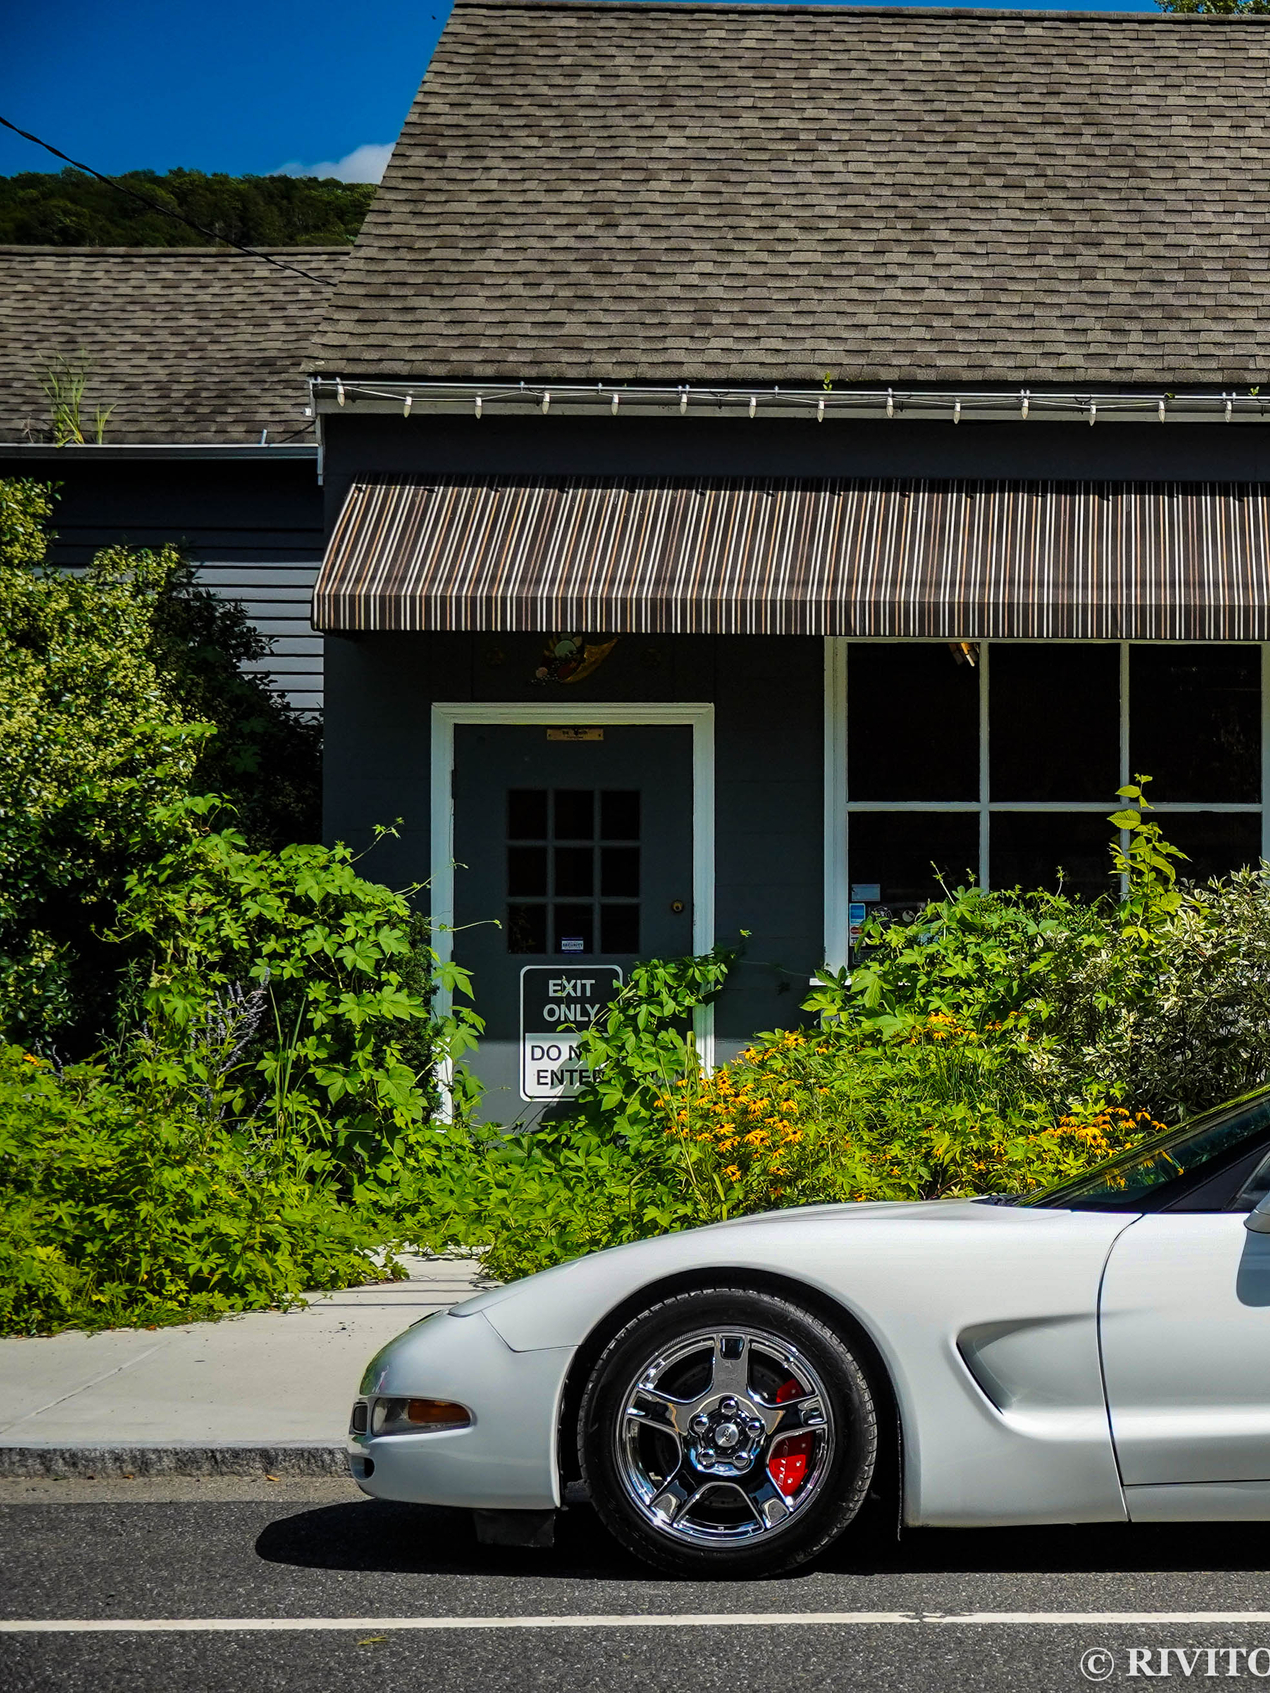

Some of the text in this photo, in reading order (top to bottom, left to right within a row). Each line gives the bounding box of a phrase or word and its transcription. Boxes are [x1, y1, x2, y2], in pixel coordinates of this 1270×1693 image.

[548, 979, 596, 997] EXIT
[543, 1003, 600, 1022] ONLY
[531, 1044, 562, 1062] DO
